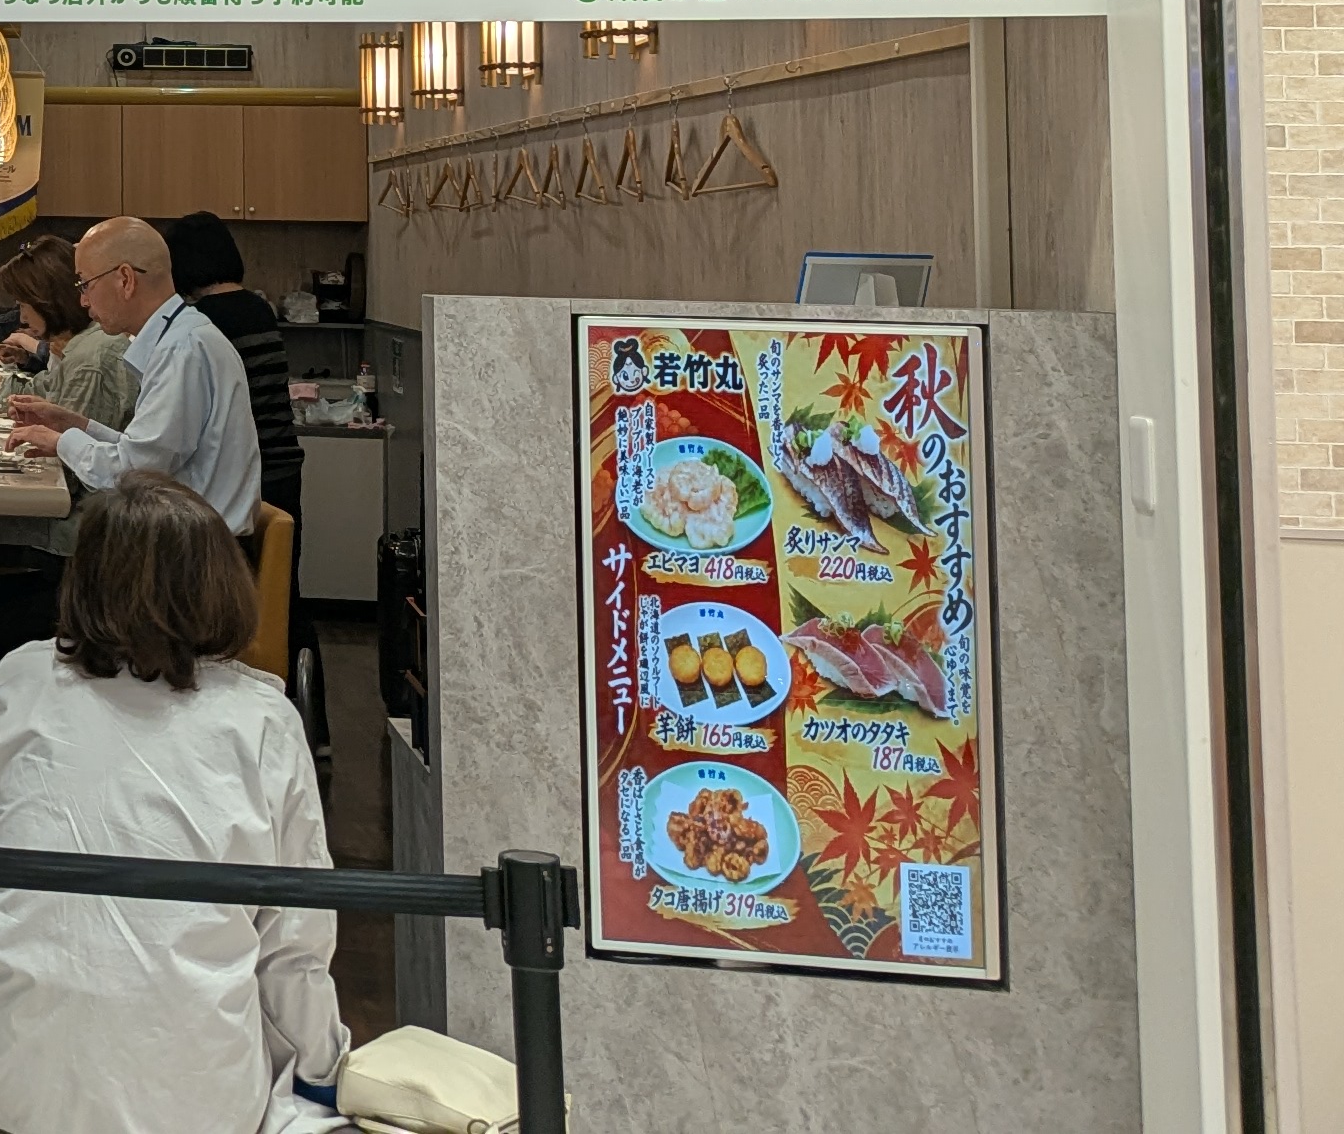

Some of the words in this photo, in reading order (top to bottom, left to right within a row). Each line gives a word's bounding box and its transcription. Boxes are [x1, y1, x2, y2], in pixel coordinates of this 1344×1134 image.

[653, 352, 744, 391] 若竹丸
[883, 342, 974, 637] 秋のおすすめ
[783, 525, 861, 555] 炙りサンマ
[647, 551, 700, 574] エビマヨ
[704, 556, 768, 582] 418円税込
[818, 556, 894, 583] 220円税込
[602, 543, 633, 735] サイドメニュー
[649, 595, 662, 709] 北海道のソウルフード
[958, 634, 973, 715] 旬の味覚を
[655, 714, 697, 744] 芋餅
[703, 723, 768, 750] 165円税込
[802, 716, 910, 747] カツオのタタキ
[872, 746, 941, 775] 187円税込
[651, 886, 724, 914] タコ唐揚げ
[724, 892, 789, 921] 319円税込
